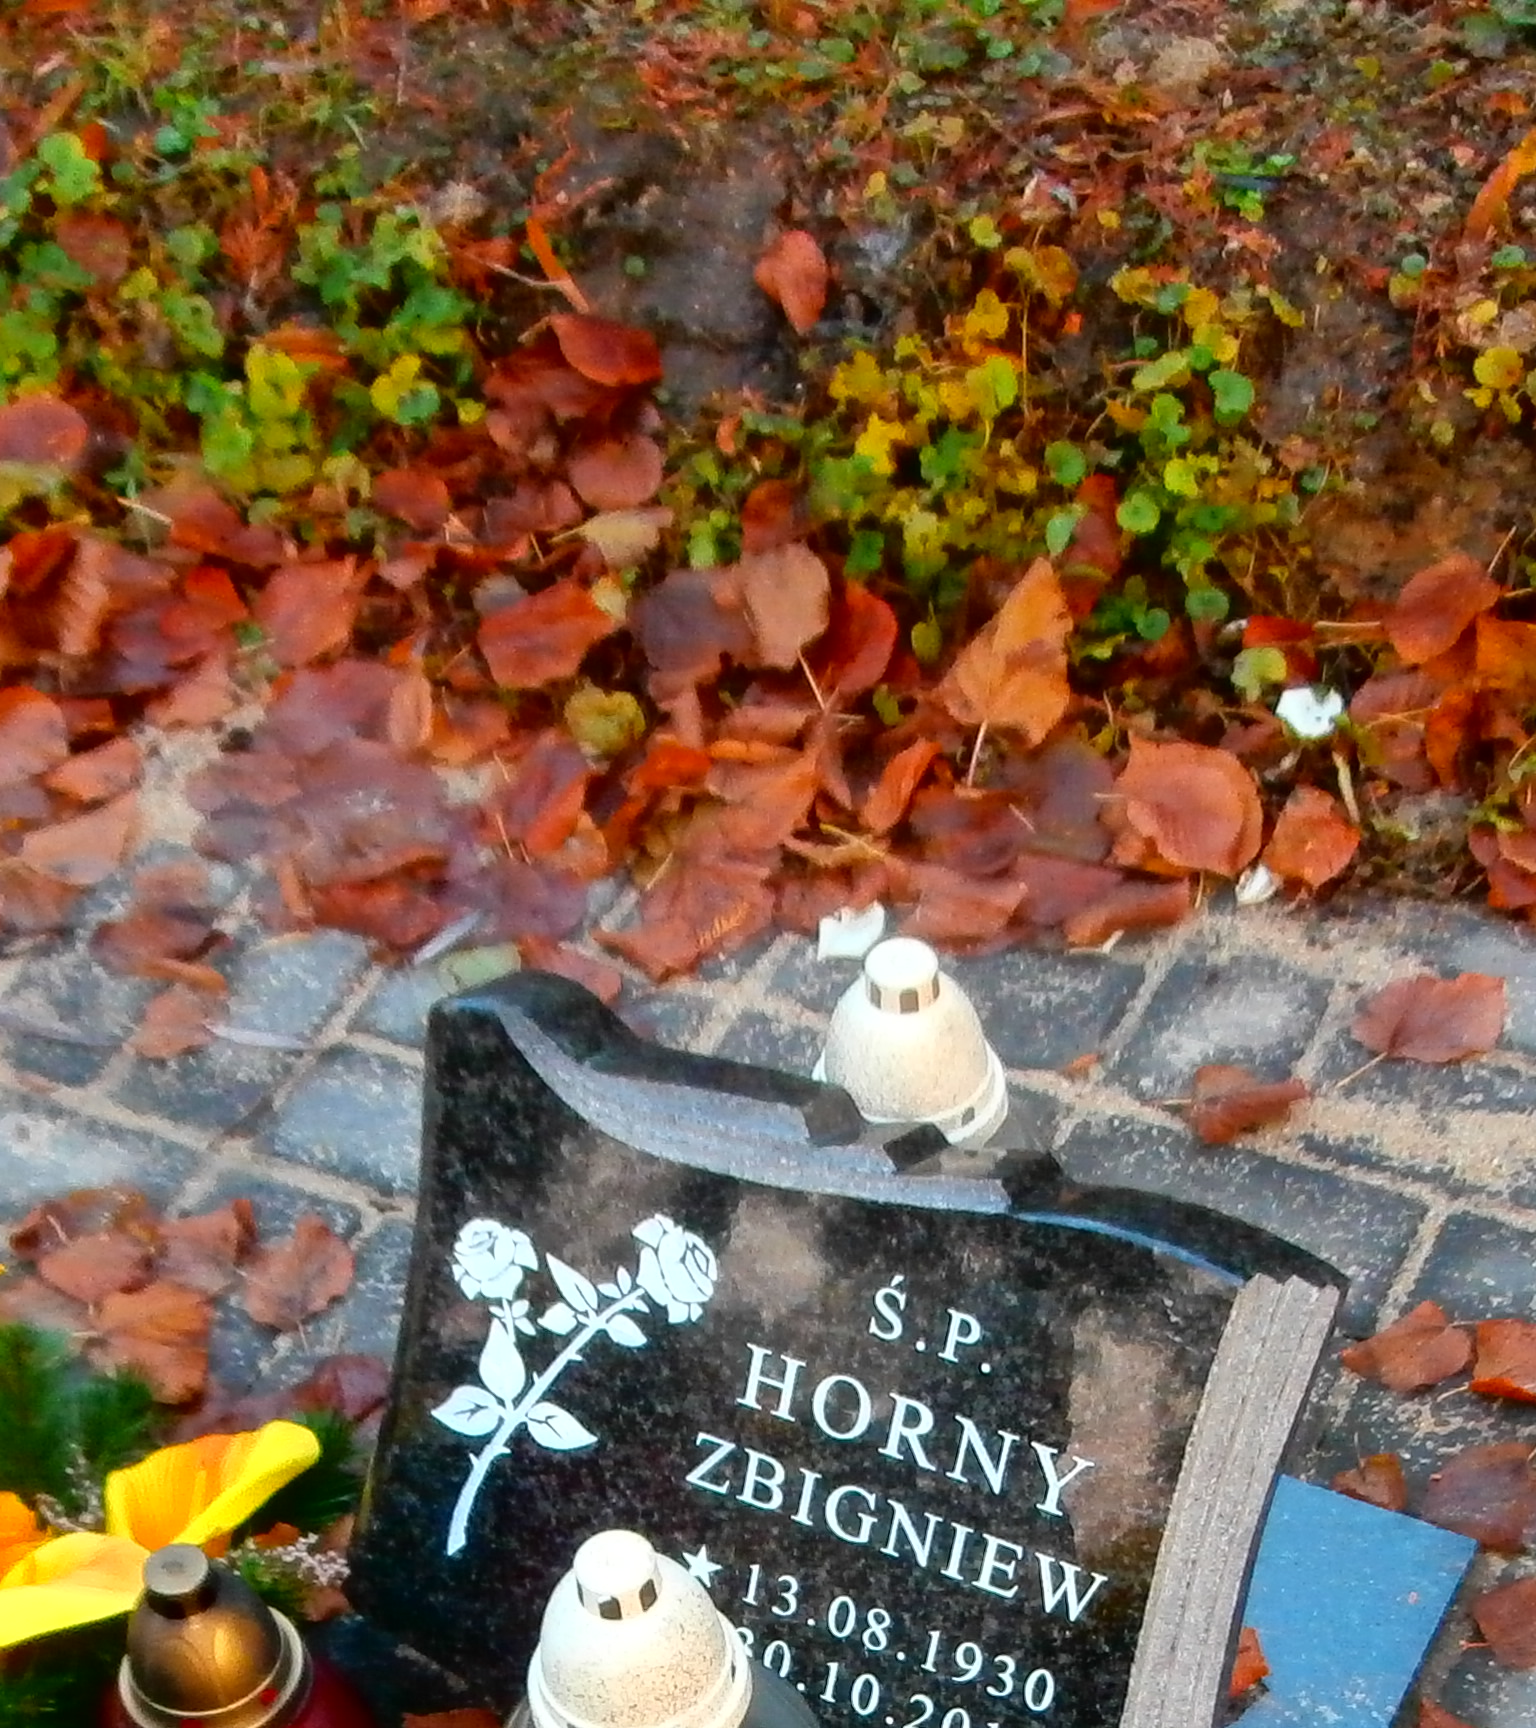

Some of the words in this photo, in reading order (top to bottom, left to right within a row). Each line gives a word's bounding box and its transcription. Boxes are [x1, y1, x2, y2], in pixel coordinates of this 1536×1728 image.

[868, 1274, 991, 1374] Ś.P.
[735, 1342, 1096, 1517] HORNY
[684, 1431, 1109, 1623] ZBIGNIEW
[741, 1563, 1055, 1713] 13.08.1930
